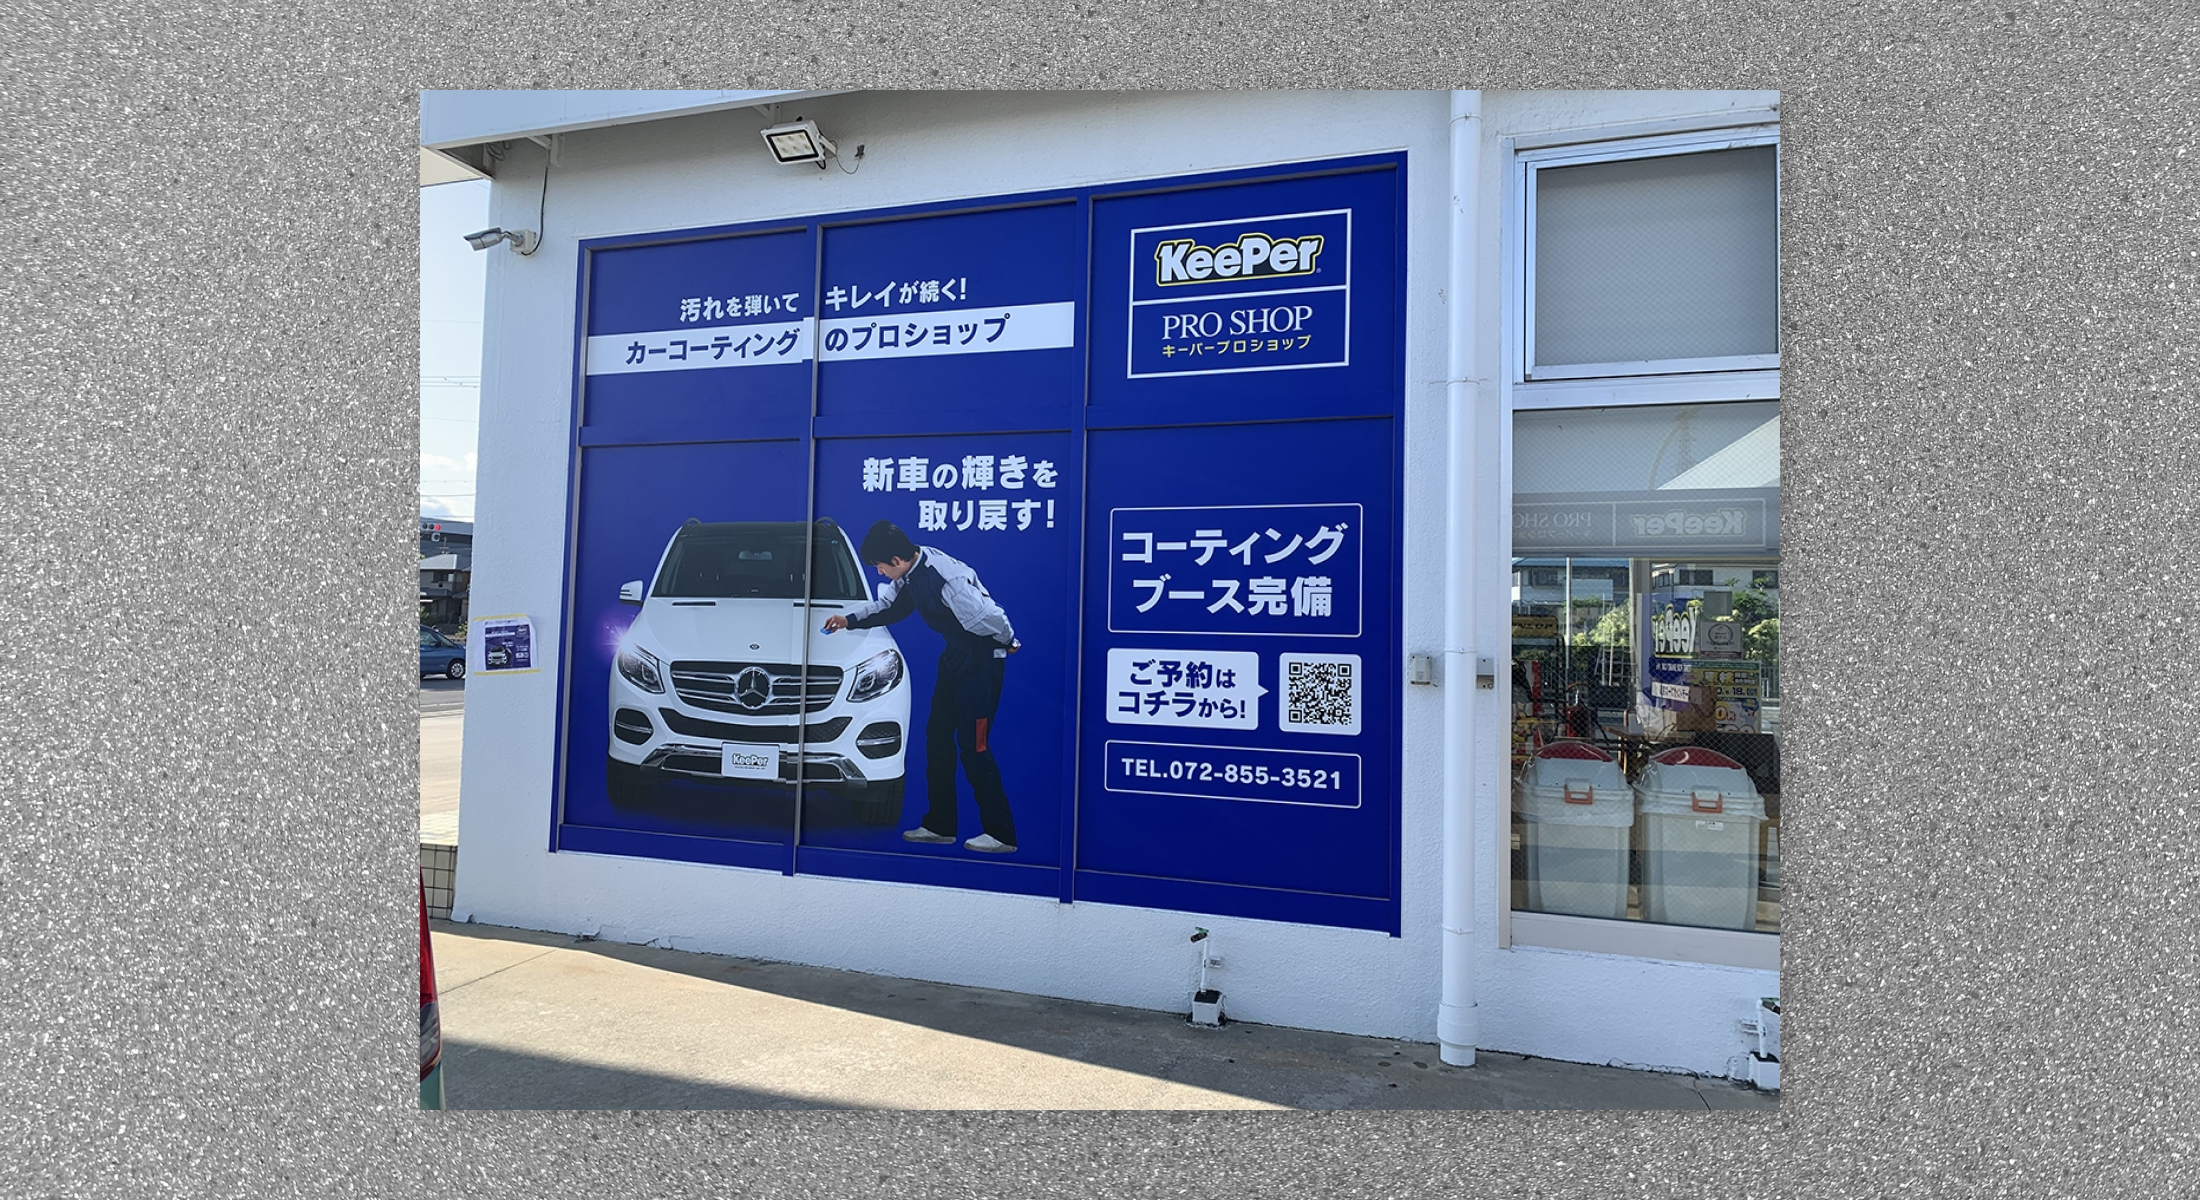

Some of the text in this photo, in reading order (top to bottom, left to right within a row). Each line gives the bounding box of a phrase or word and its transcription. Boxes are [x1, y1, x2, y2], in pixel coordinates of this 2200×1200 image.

[1155, 234, 1323, 285] KeePer
[679, 278, 967, 323] 汚れを弾いて キレイが続く!
[625, 313, 1011, 365] カーコーティング のプロショップ
[1161, 305, 1313, 340] PRO SHOP
[1162, 334, 1312, 358] キーパープロショップ
[862, 454, 1059, 492] 新車の輝きを
[918, 499, 1055, 532] 取り戻す!
[1121, 521, 1349, 566] コーティング
[1132, 573, 1333, 617] ブース完備
[1129, 658, 1237, 690] ご予約は
[1117, 690, 1246, 720] コチラから!
[1121, 758, 1340, 791] TEL.072-855-3521
